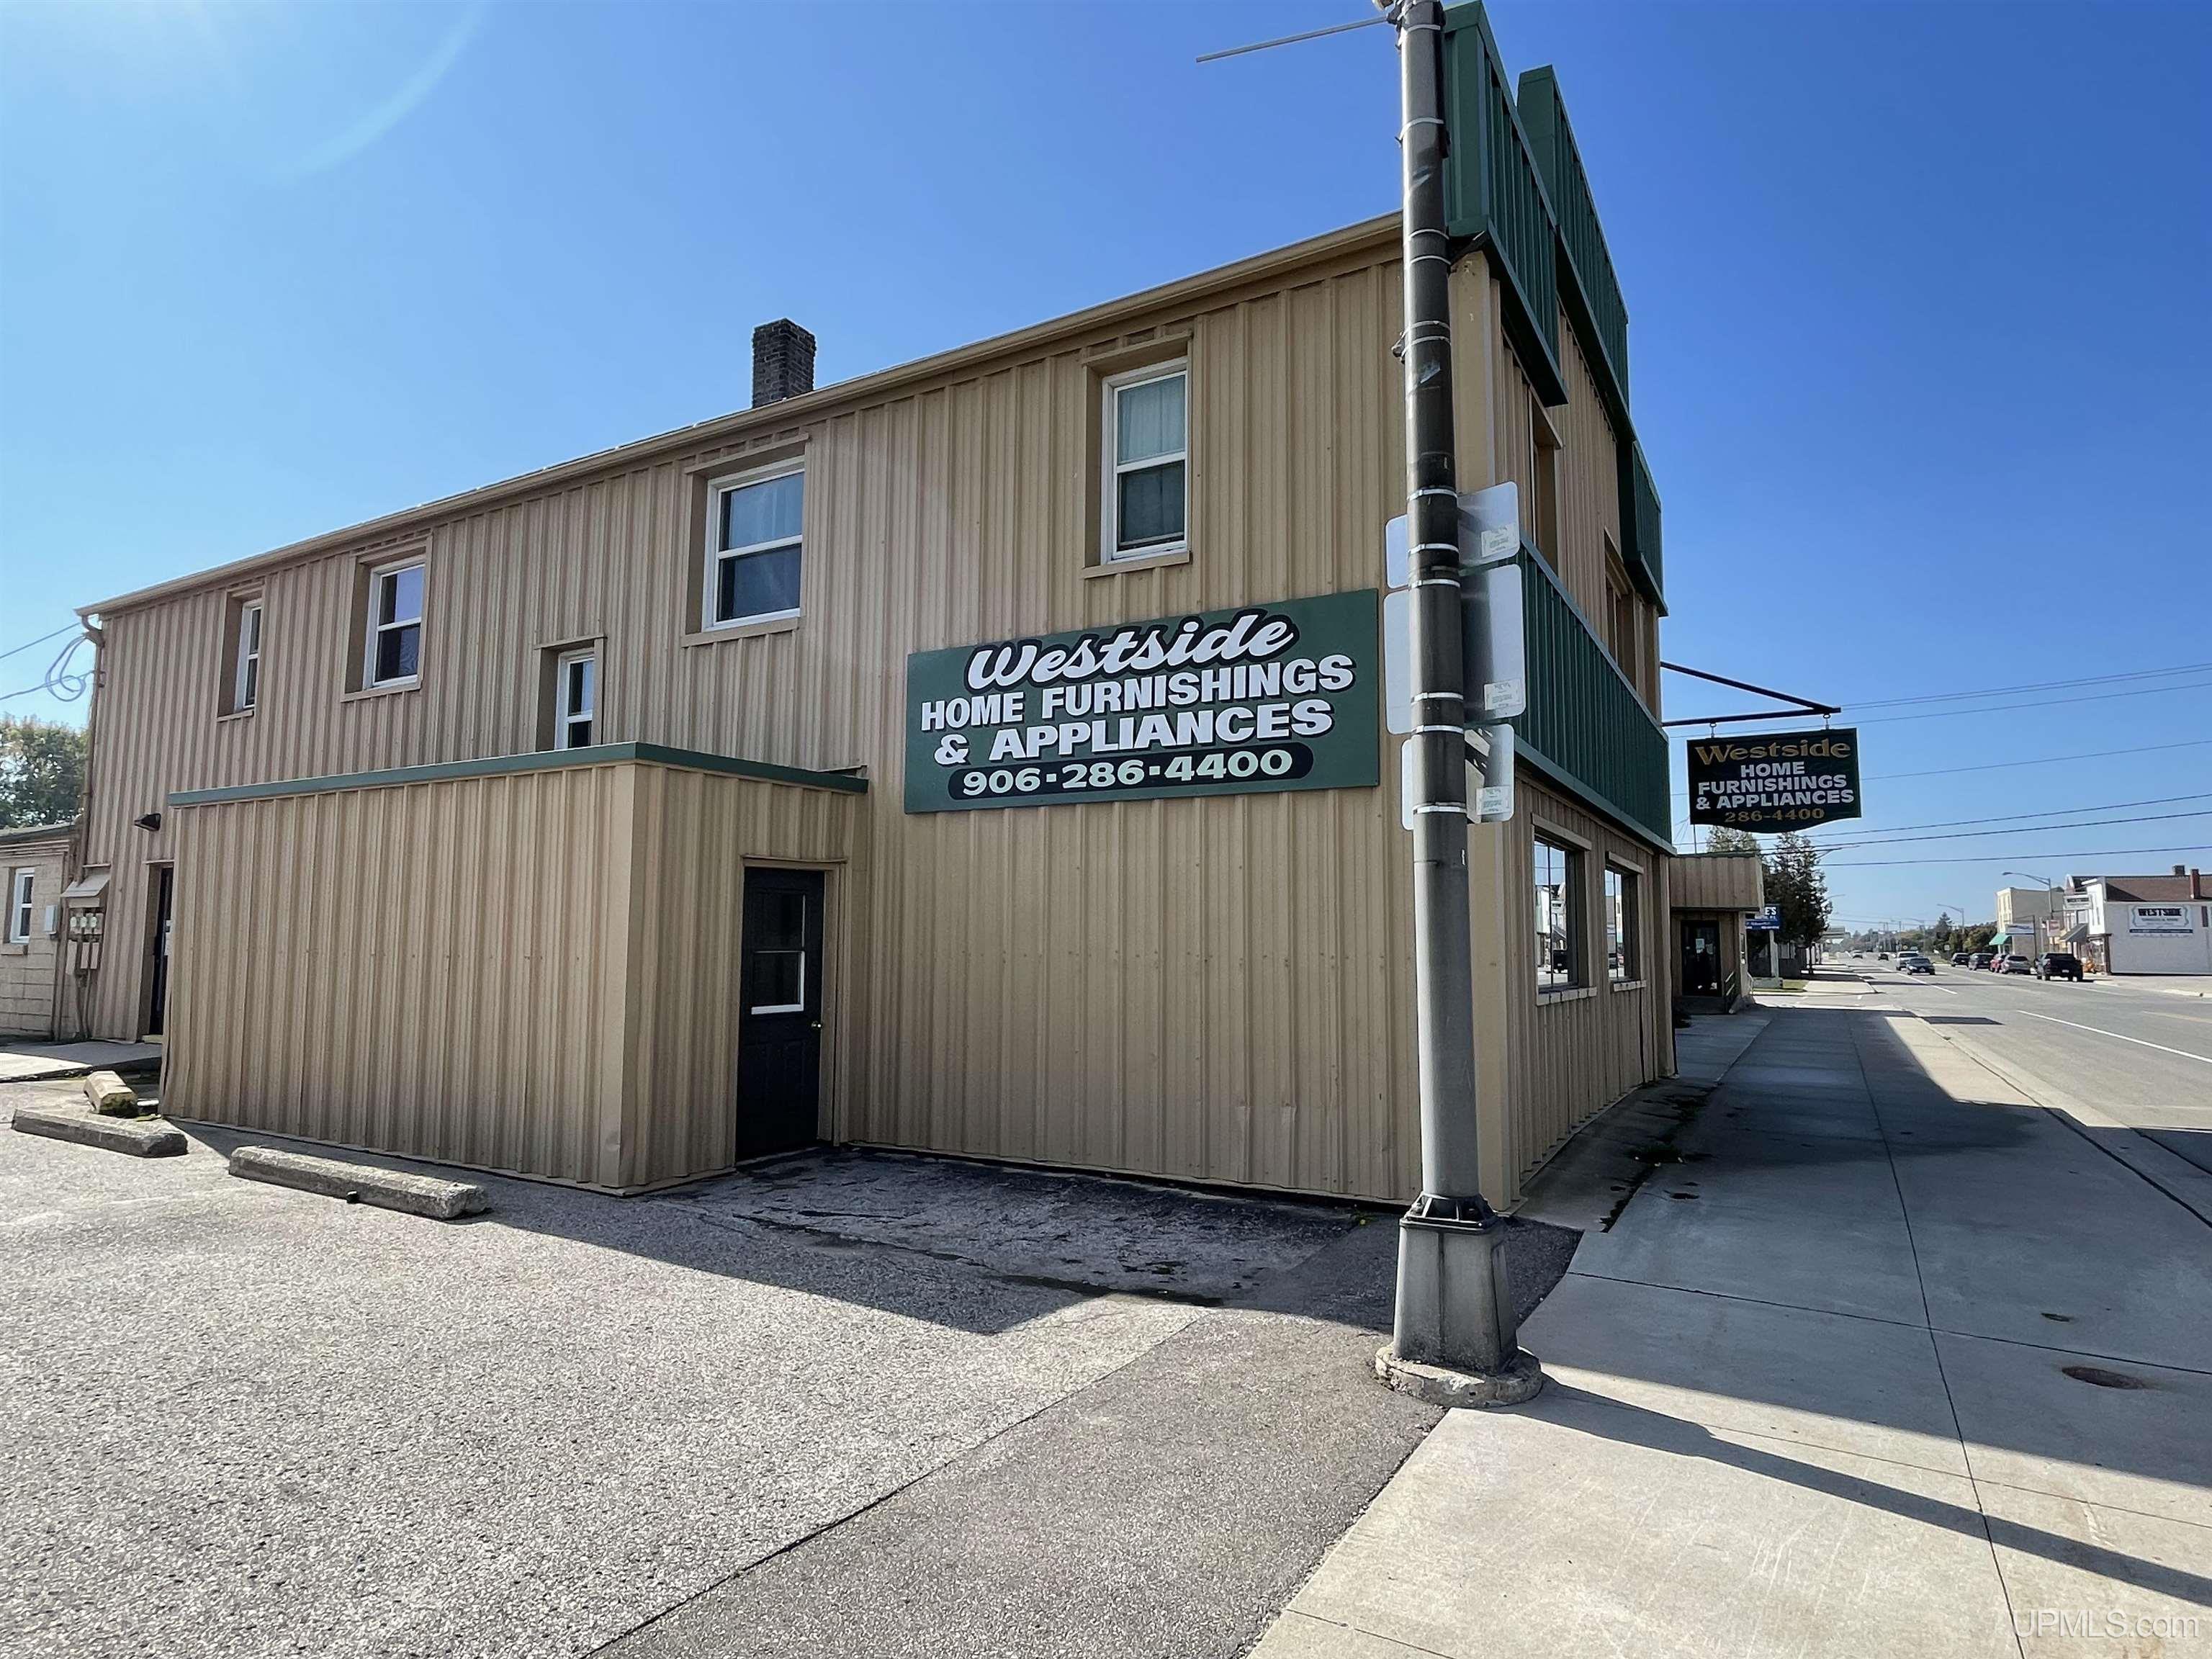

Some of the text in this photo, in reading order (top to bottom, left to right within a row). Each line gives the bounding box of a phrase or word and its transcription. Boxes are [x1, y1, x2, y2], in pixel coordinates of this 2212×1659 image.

[967, 614, 1294, 689] Westside
[921, 654, 1353, 731] HOME FURNISHINGS
[934, 698, 1332, 765] & APPLIANCES
[1695, 738, 1851, 765] Westside
[963, 750, 1292, 796] 906-286-4400
[1740, 761, 1805, 778] HOME
[1698, 774, 1847, 795] FURNISHINGS
[1696, 789, 1855, 809] & APPLIANCES
[1725, 808, 1825, 822] 286-4400
